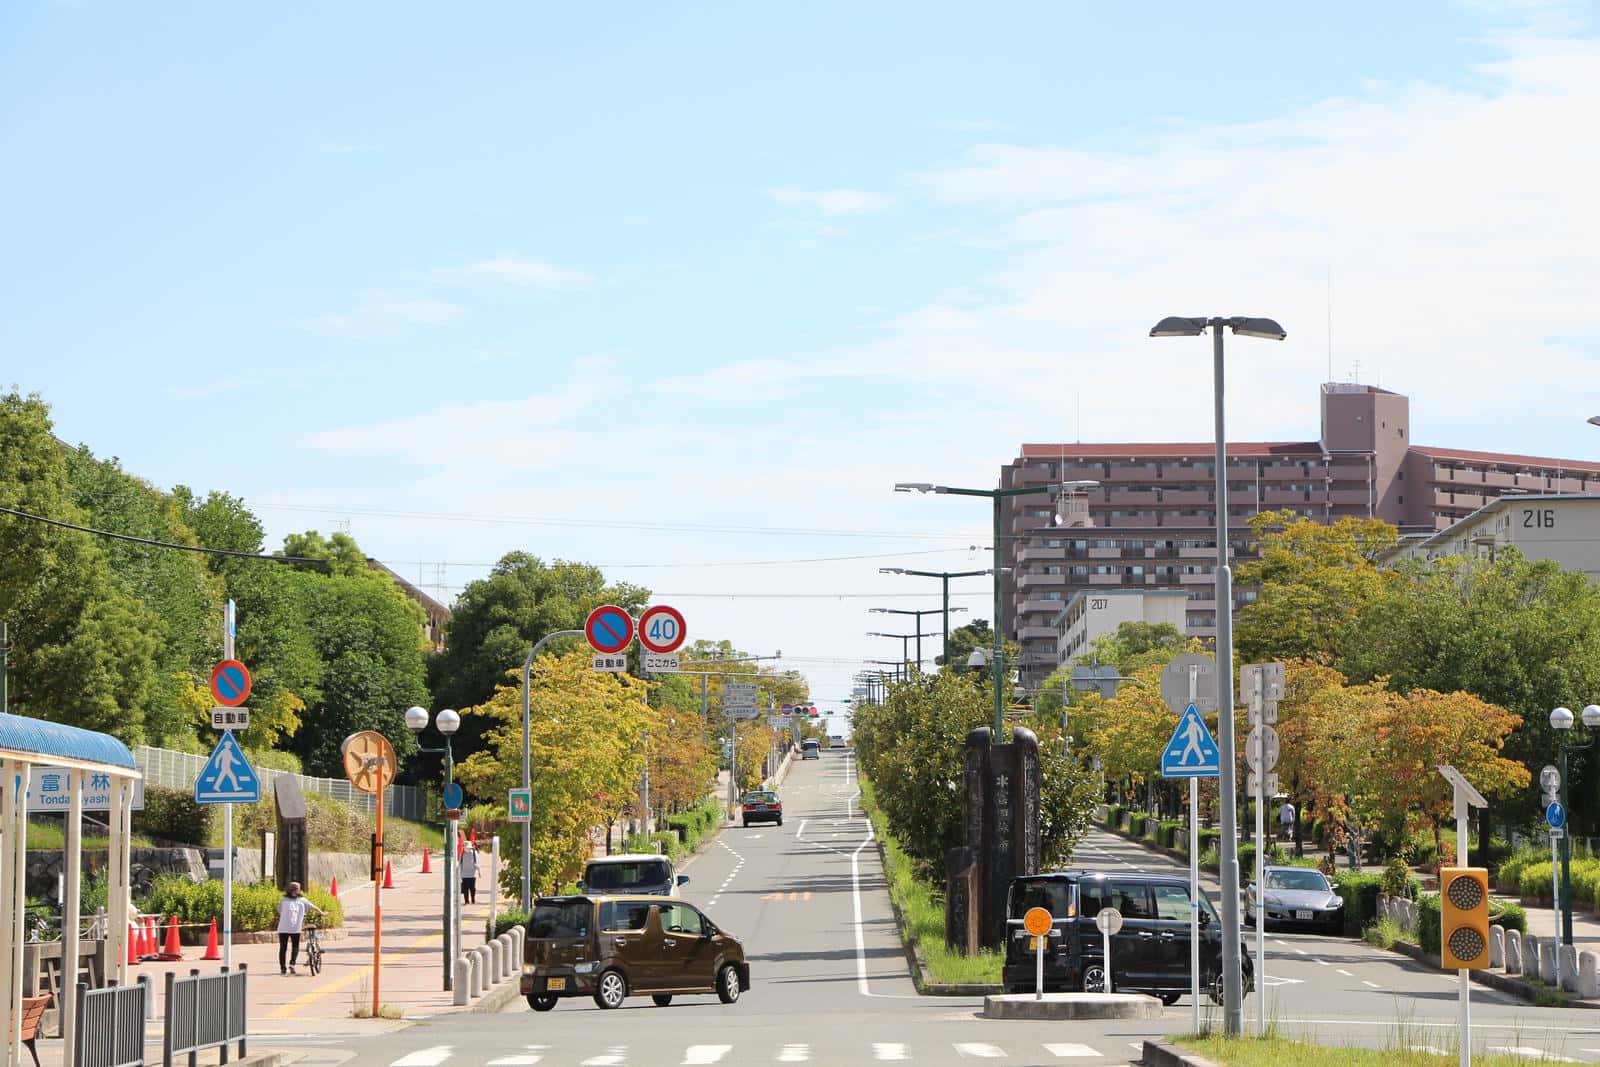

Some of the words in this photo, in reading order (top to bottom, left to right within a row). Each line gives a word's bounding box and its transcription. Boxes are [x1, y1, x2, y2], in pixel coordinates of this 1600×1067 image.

[1523, 509, 1554, 528] 216
[1091, 598, 1108, 610] 207
[649, 619, 675, 640] 40
[595, 658, 625, 668] 自動車
[647, 658, 678, 668] ここから
[214, 711, 248, 724] 自動車
[40, 793, 110, 806] Tondayashi
